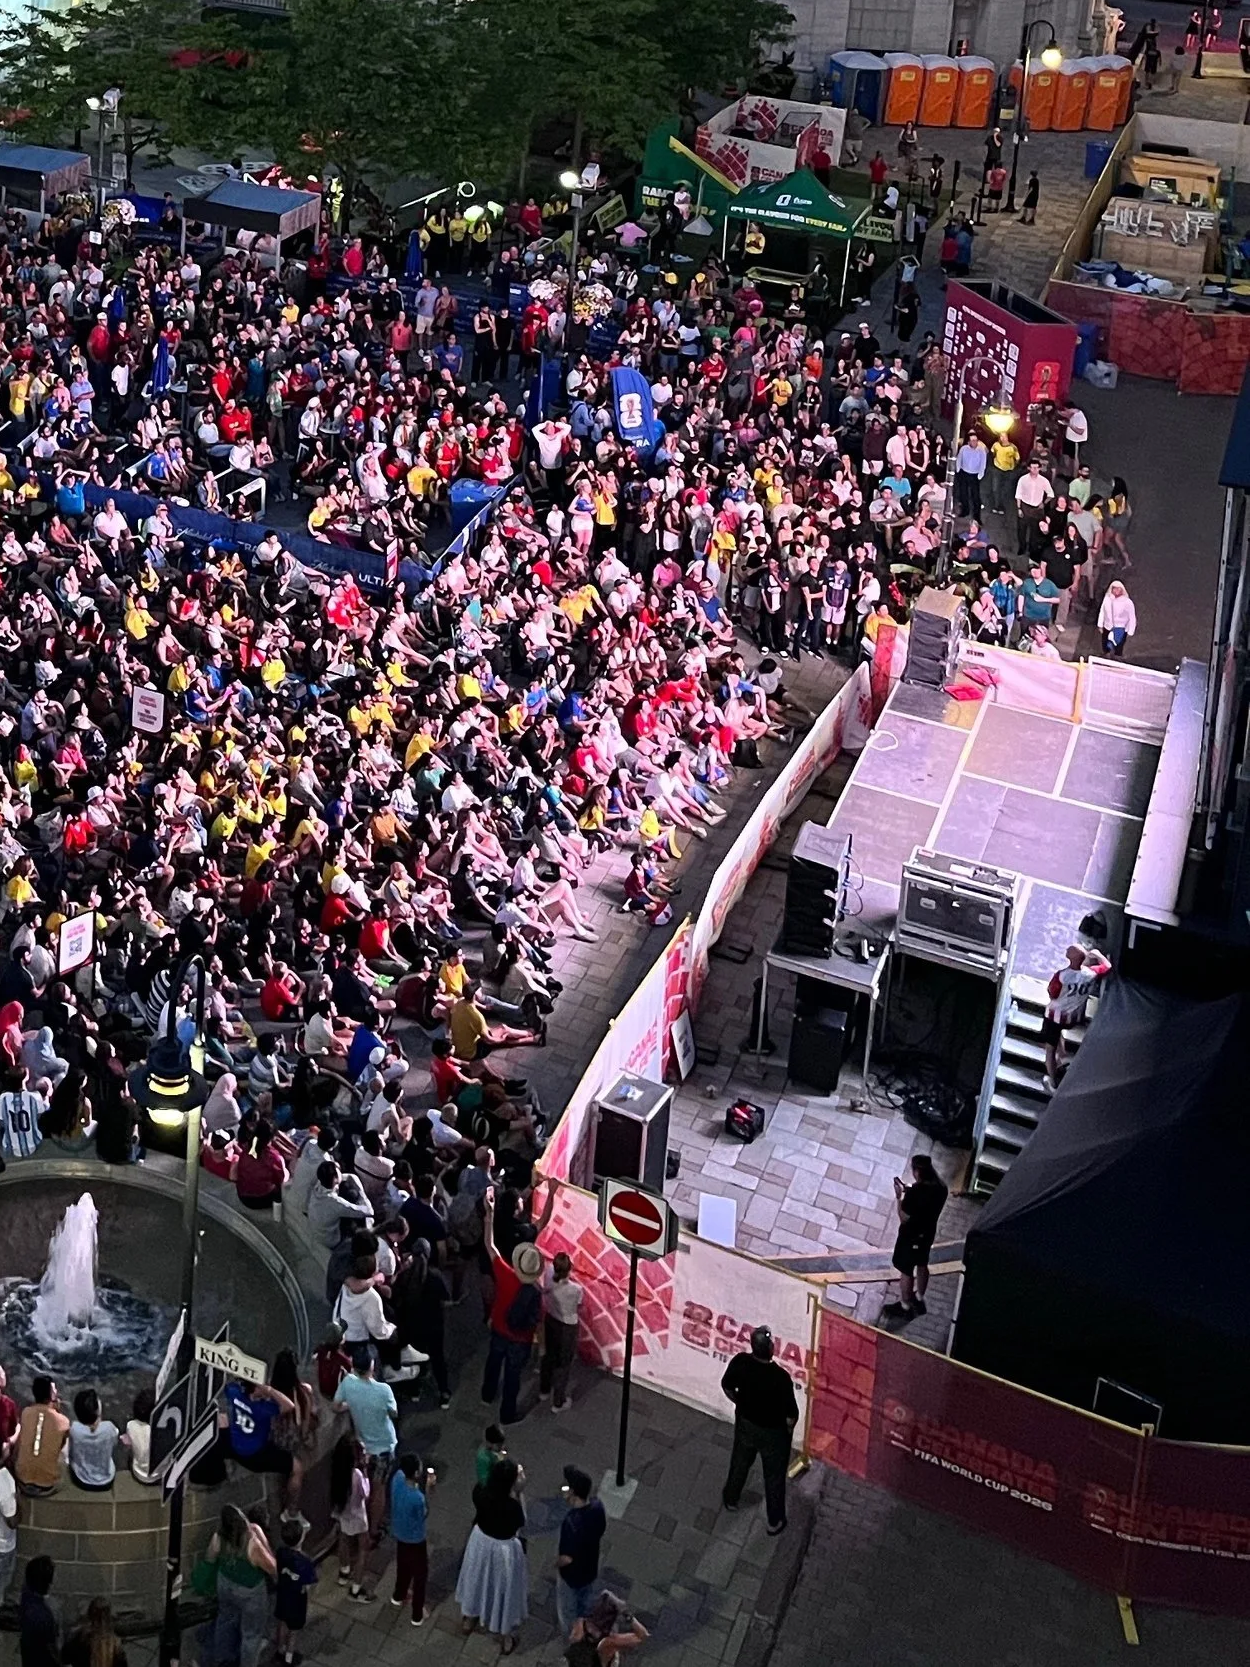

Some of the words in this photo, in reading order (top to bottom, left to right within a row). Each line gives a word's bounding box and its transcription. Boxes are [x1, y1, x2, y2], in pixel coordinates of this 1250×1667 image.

[9, 1109, 30, 1133] 10
[200, 1346, 239, 1372] KING
[914, 1448, 940, 1466] FIFA
[941, 1457, 983, 1484] WORLD
[984, 1478, 1009, 1493] CUP
[1010, 1489, 1053, 1512] 2026
[1203, 1547, 1215, 1555] LA
